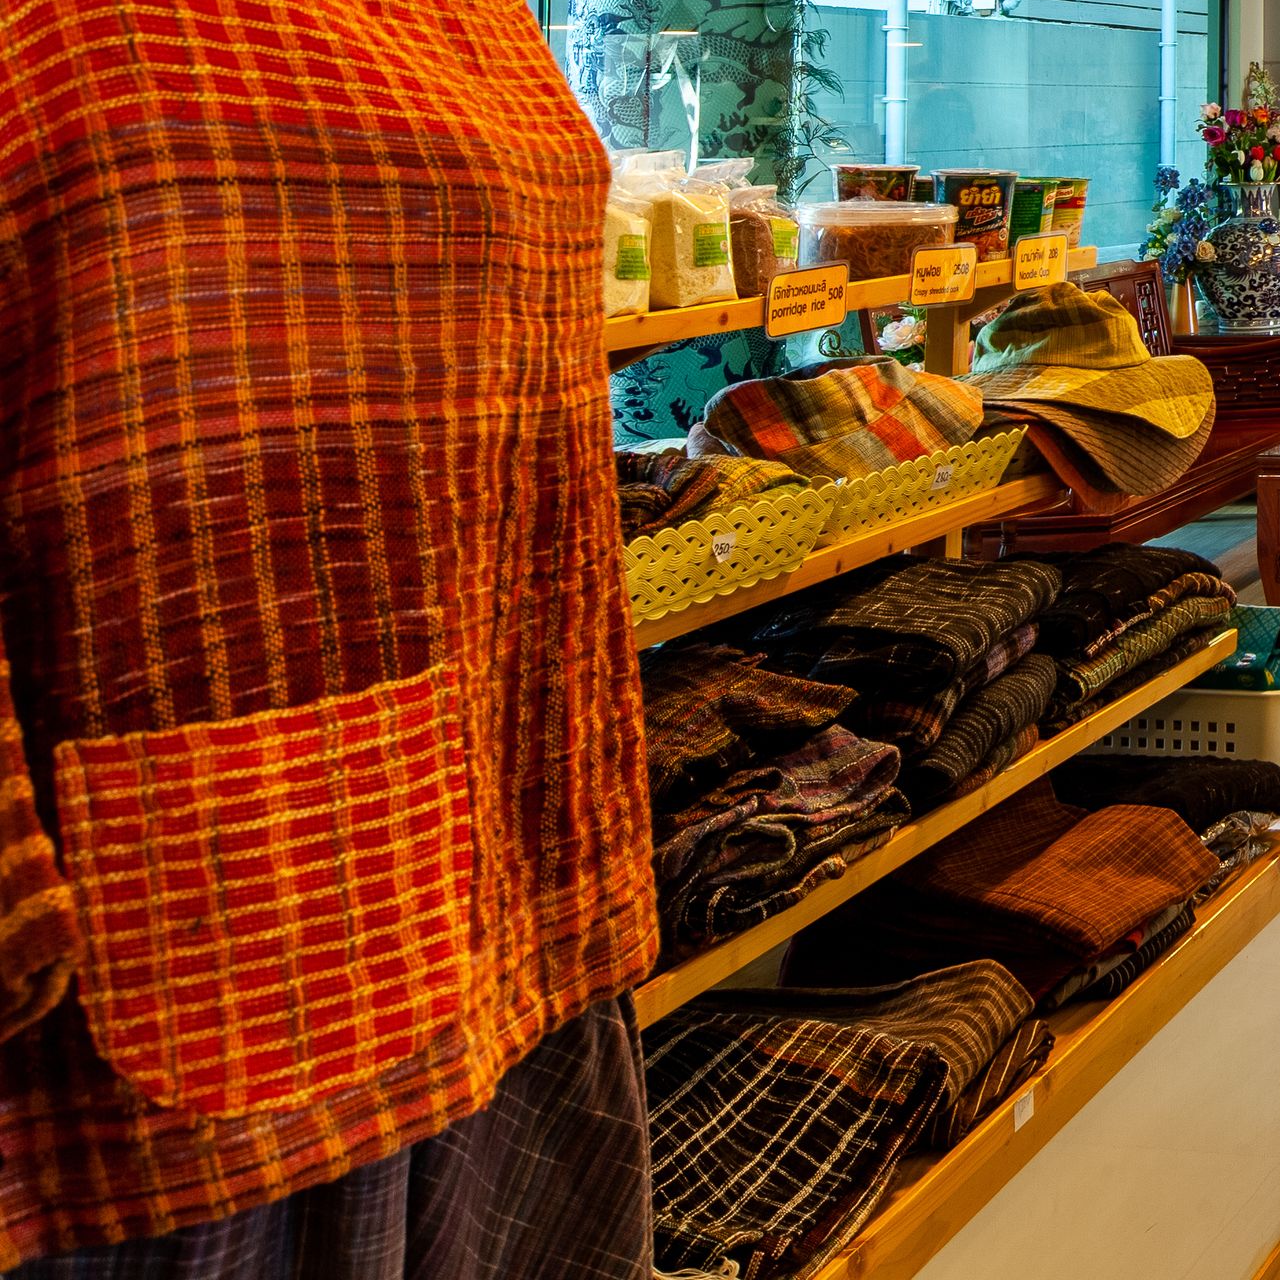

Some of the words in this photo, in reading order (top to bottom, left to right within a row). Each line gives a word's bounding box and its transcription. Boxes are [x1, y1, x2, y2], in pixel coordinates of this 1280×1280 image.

[1019, 268, 1038, 280] Noodle
[772, 302, 807, 321] porridge
[811, 299, 826, 312] rice
